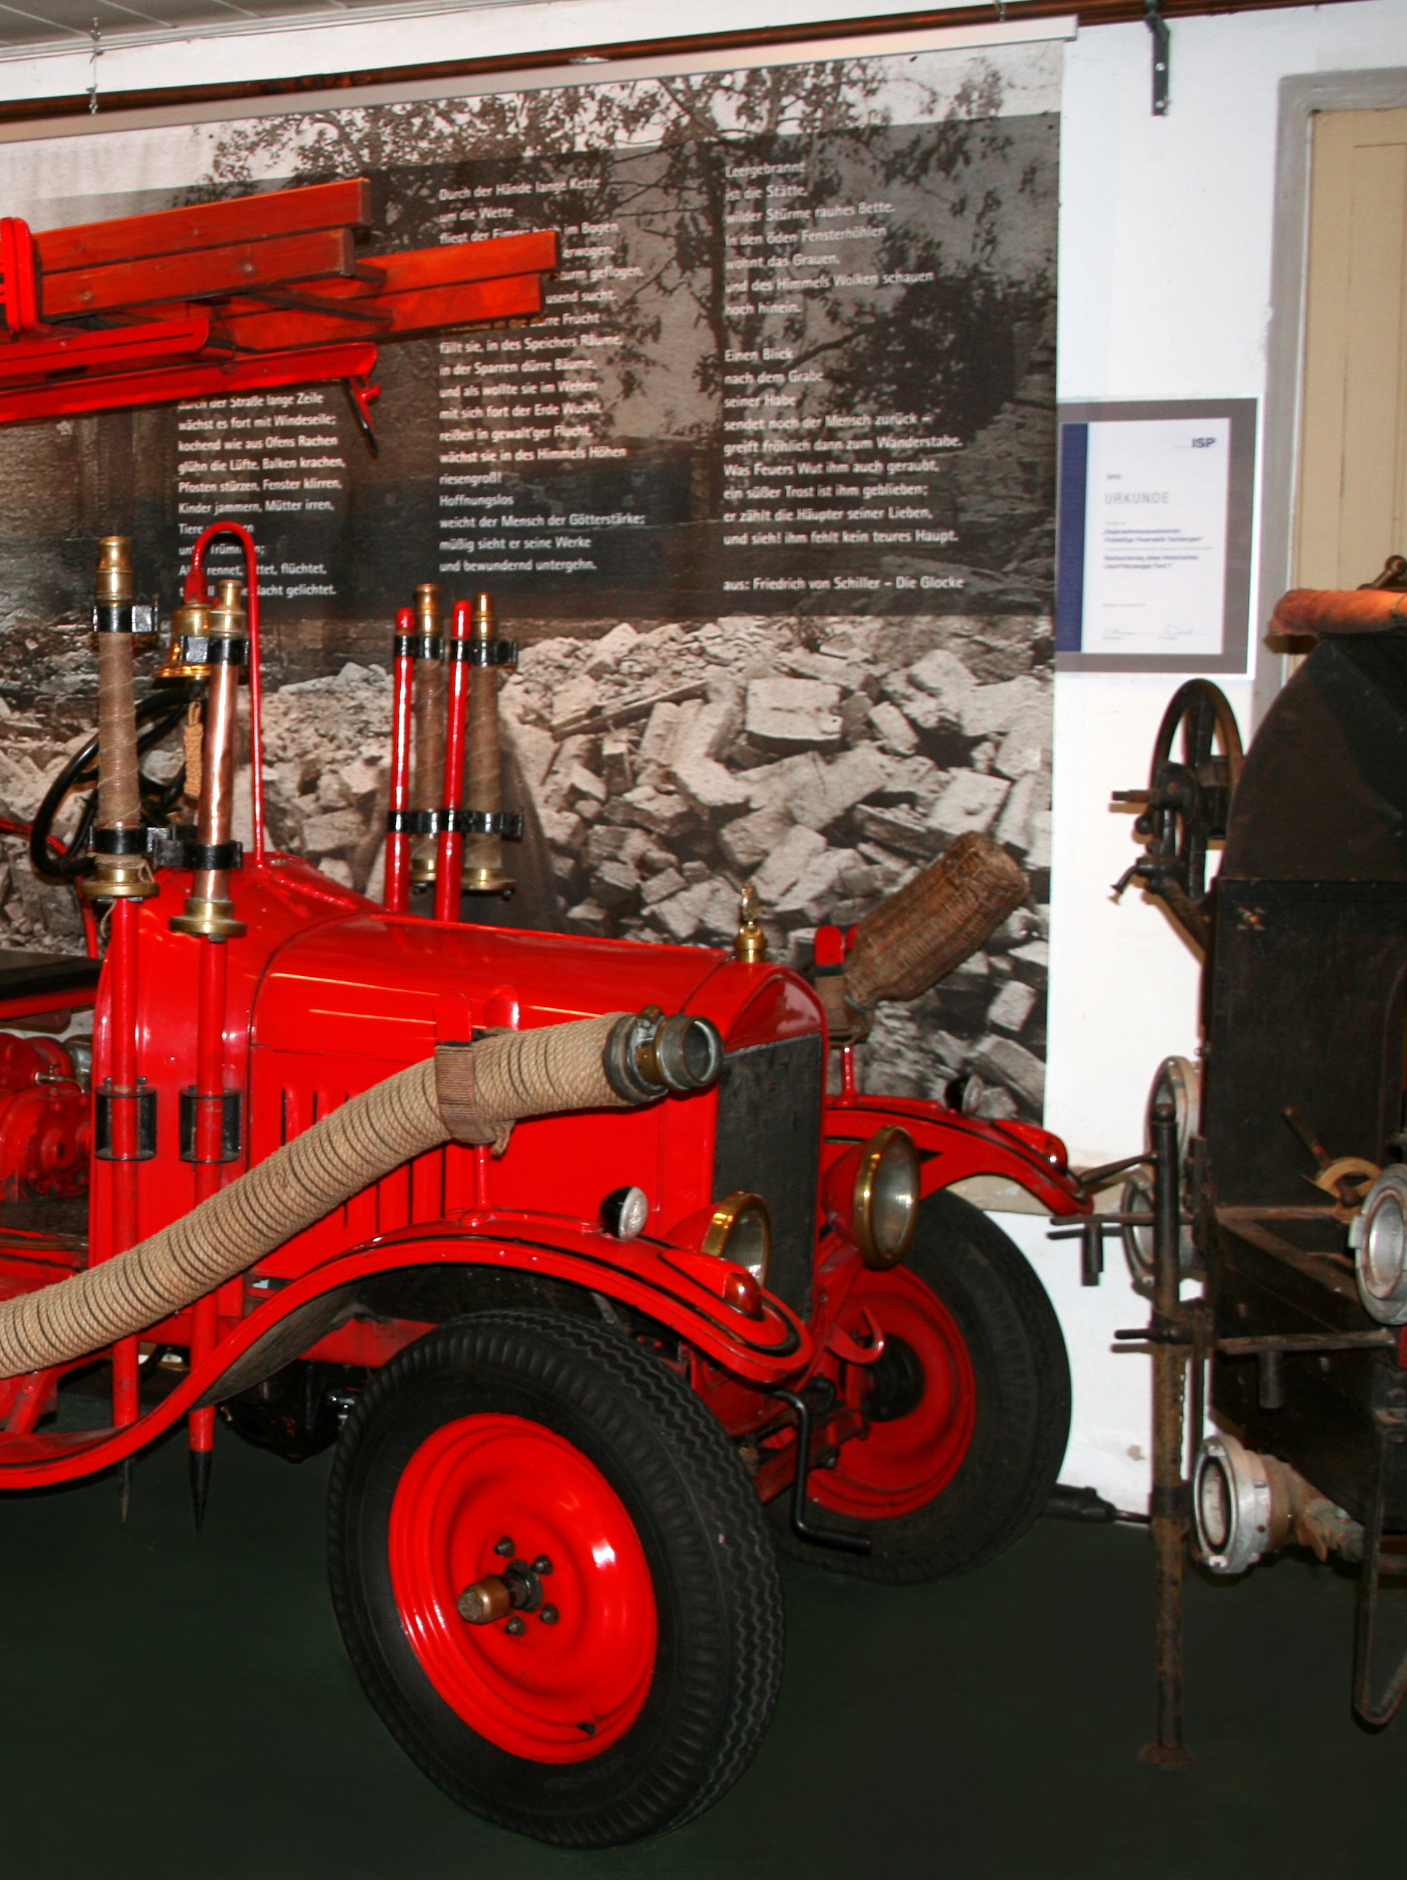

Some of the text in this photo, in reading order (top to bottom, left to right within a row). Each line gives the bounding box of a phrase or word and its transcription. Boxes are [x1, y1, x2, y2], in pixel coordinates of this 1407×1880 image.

[726, 162, 806, 179] Leergebrannt
[439, 178, 600, 200] Durch der Hände lange Kette
[726, 187, 762, 200] ist die
[439, 208, 514, 222] um die Wette
[726, 205, 856, 223] wilder Stürme rauhes
[564, 224, 579, 234] im
[581, 222, 619, 235] Bogen
[740, 234, 763, 245] den
[766, 232, 799, 244] öden
[802, 226, 887, 242] Fensterhöhlen
[725, 256, 790, 269] wohnt das
[725, 271, 934, 292] und des Himmels Wolken schauen
[725, 304, 755, 315] hoch
[562, 313, 601, 324] Frucht
[440, 342, 462, 353] fällt
[486, 340, 498, 351] in
[501, 339, 522, 350] des
[725, 348, 793, 361] Einen Blick
[440, 360, 552, 376] in der Sparren dürre
[724, 370, 824, 384] nach dem Grabe
[439, 386, 461, 398] und
[463, 385, 480, 397] als
[482, 383, 518, 395] wollte
[521, 382, 538, 394] sie
[540, 382, 555, 392] im
[230, 392, 324, 407] Straße lange Zeile
[724, 394, 797, 408] seiner Habe
[439, 404, 560, 419] mit sich fort der Erde
[178, 417, 272, 430] wächst es fort mit
[724, 412, 918, 430] sendet noch der Mensch zurück
[440, 429, 474, 441] reißen
[477, 428, 489, 440] in
[178, 435, 338, 450] kochend wie aus Ofens Rachen
[724, 442, 759, 456] greift
[762, 440, 811, 453] fröhlich
[814, 440, 842, 451] dann
[845, 440, 873, 450] zum
[1192, 437, 1216, 448] ISP
[440, 446, 627, 463] wächst sie in des Himmels Höhen
[178, 458, 297, 475] glühn die Balken
[723, 460, 883, 476] Was Feuers Wut ihm auch
[440, 471, 502, 486] riesengroß!
[178, 482, 217, 493] Pfosten
[263, 479, 301, 490] Fenster
[723, 487, 743, 499] ein
[746, 486, 782, 499] süßer
[786, 486, 815, 498] Trost
[817, 485, 833, 497] ist
[836, 484, 859, 496] ihm
[440, 494, 514, 508] Hoffnungslos
[1104, 491, 1169, 504] URKUNDE
[178, 503, 212, 513] Kinder
[265, 500, 302, 511] Mütter
[440, 515, 566, 528] weicht der Mensch der
[723, 512, 738, 522] er
[739, 509, 772, 522] zählt
[774, 509, 794, 521] die
[797, 508, 844, 522] Häupter
[847, 508, 885, 520] seiner
[179, 524, 203, 534] Tiere
[723, 529, 959, 545] und sieh! ihm fehlt kein teures Haupt.
[440, 536, 591, 553] müßig sieht er seine Werke
[440, 558, 597, 574] und bewundernd untergehn.
[723, 576, 964, 590] aus: Friedrich von Schiller Die Glocke
